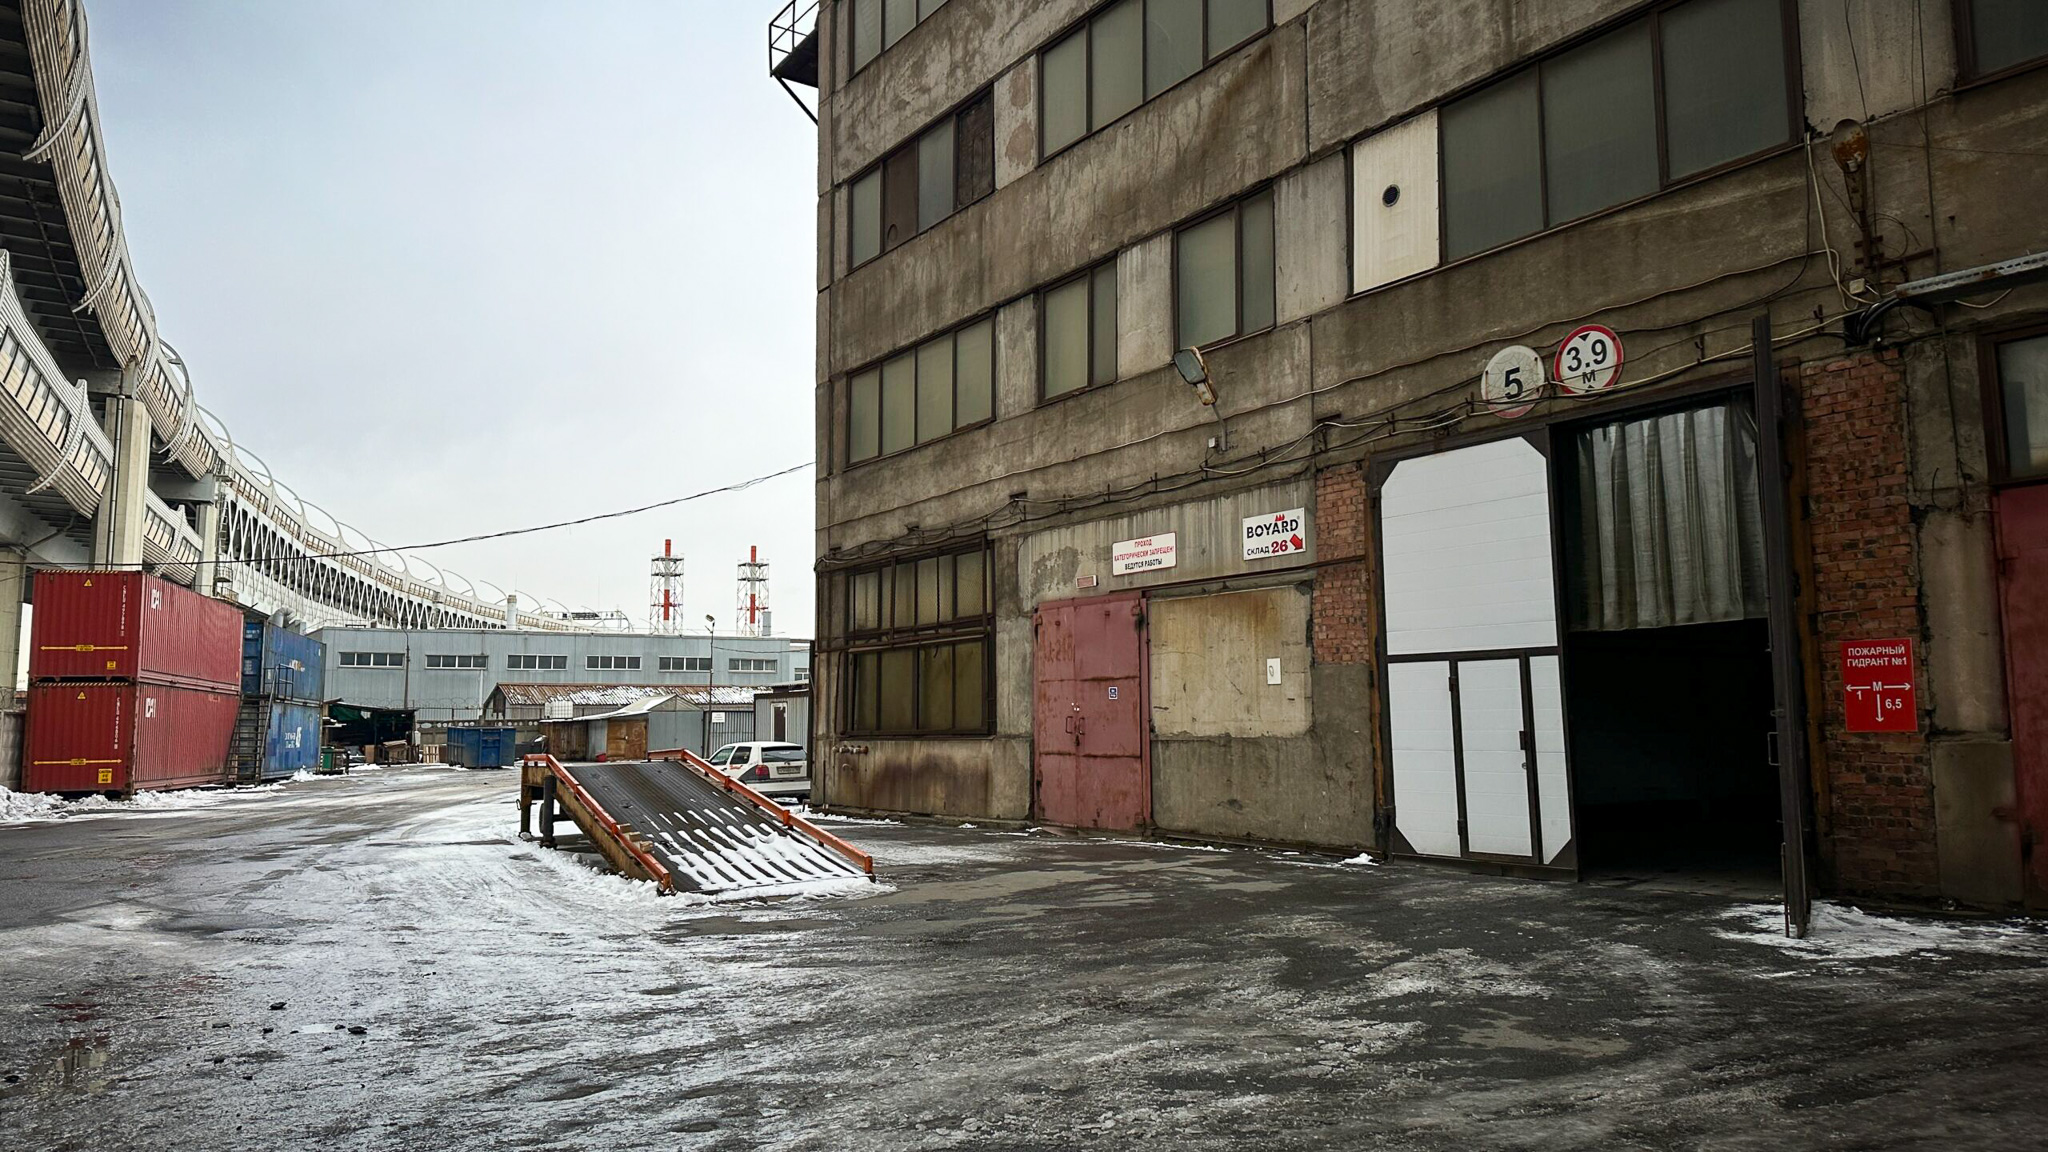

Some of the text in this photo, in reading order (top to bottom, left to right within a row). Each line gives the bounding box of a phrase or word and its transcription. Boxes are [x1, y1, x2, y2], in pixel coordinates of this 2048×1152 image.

[1566, 339, 1607, 372] 3.9
[1504, 366, 1523, 399] 5
[1246, 518, 1299, 539] BOYARD
[1134, 539, 1152, 548] ПРОХОД
[1246, 539, 1289, 556] СКЛАД 26
[1124, 558, 1163, 570] ВЕДУТСЯ РАБОТЫ
[1847, 643, 1905, 656] ПОЖАРНЫЙ
[1847, 657, 1907, 668] ГИДРАНТ №1
[1856, 690, 1862, 700] 1
[1885, 698, 1902, 710] 6,5
